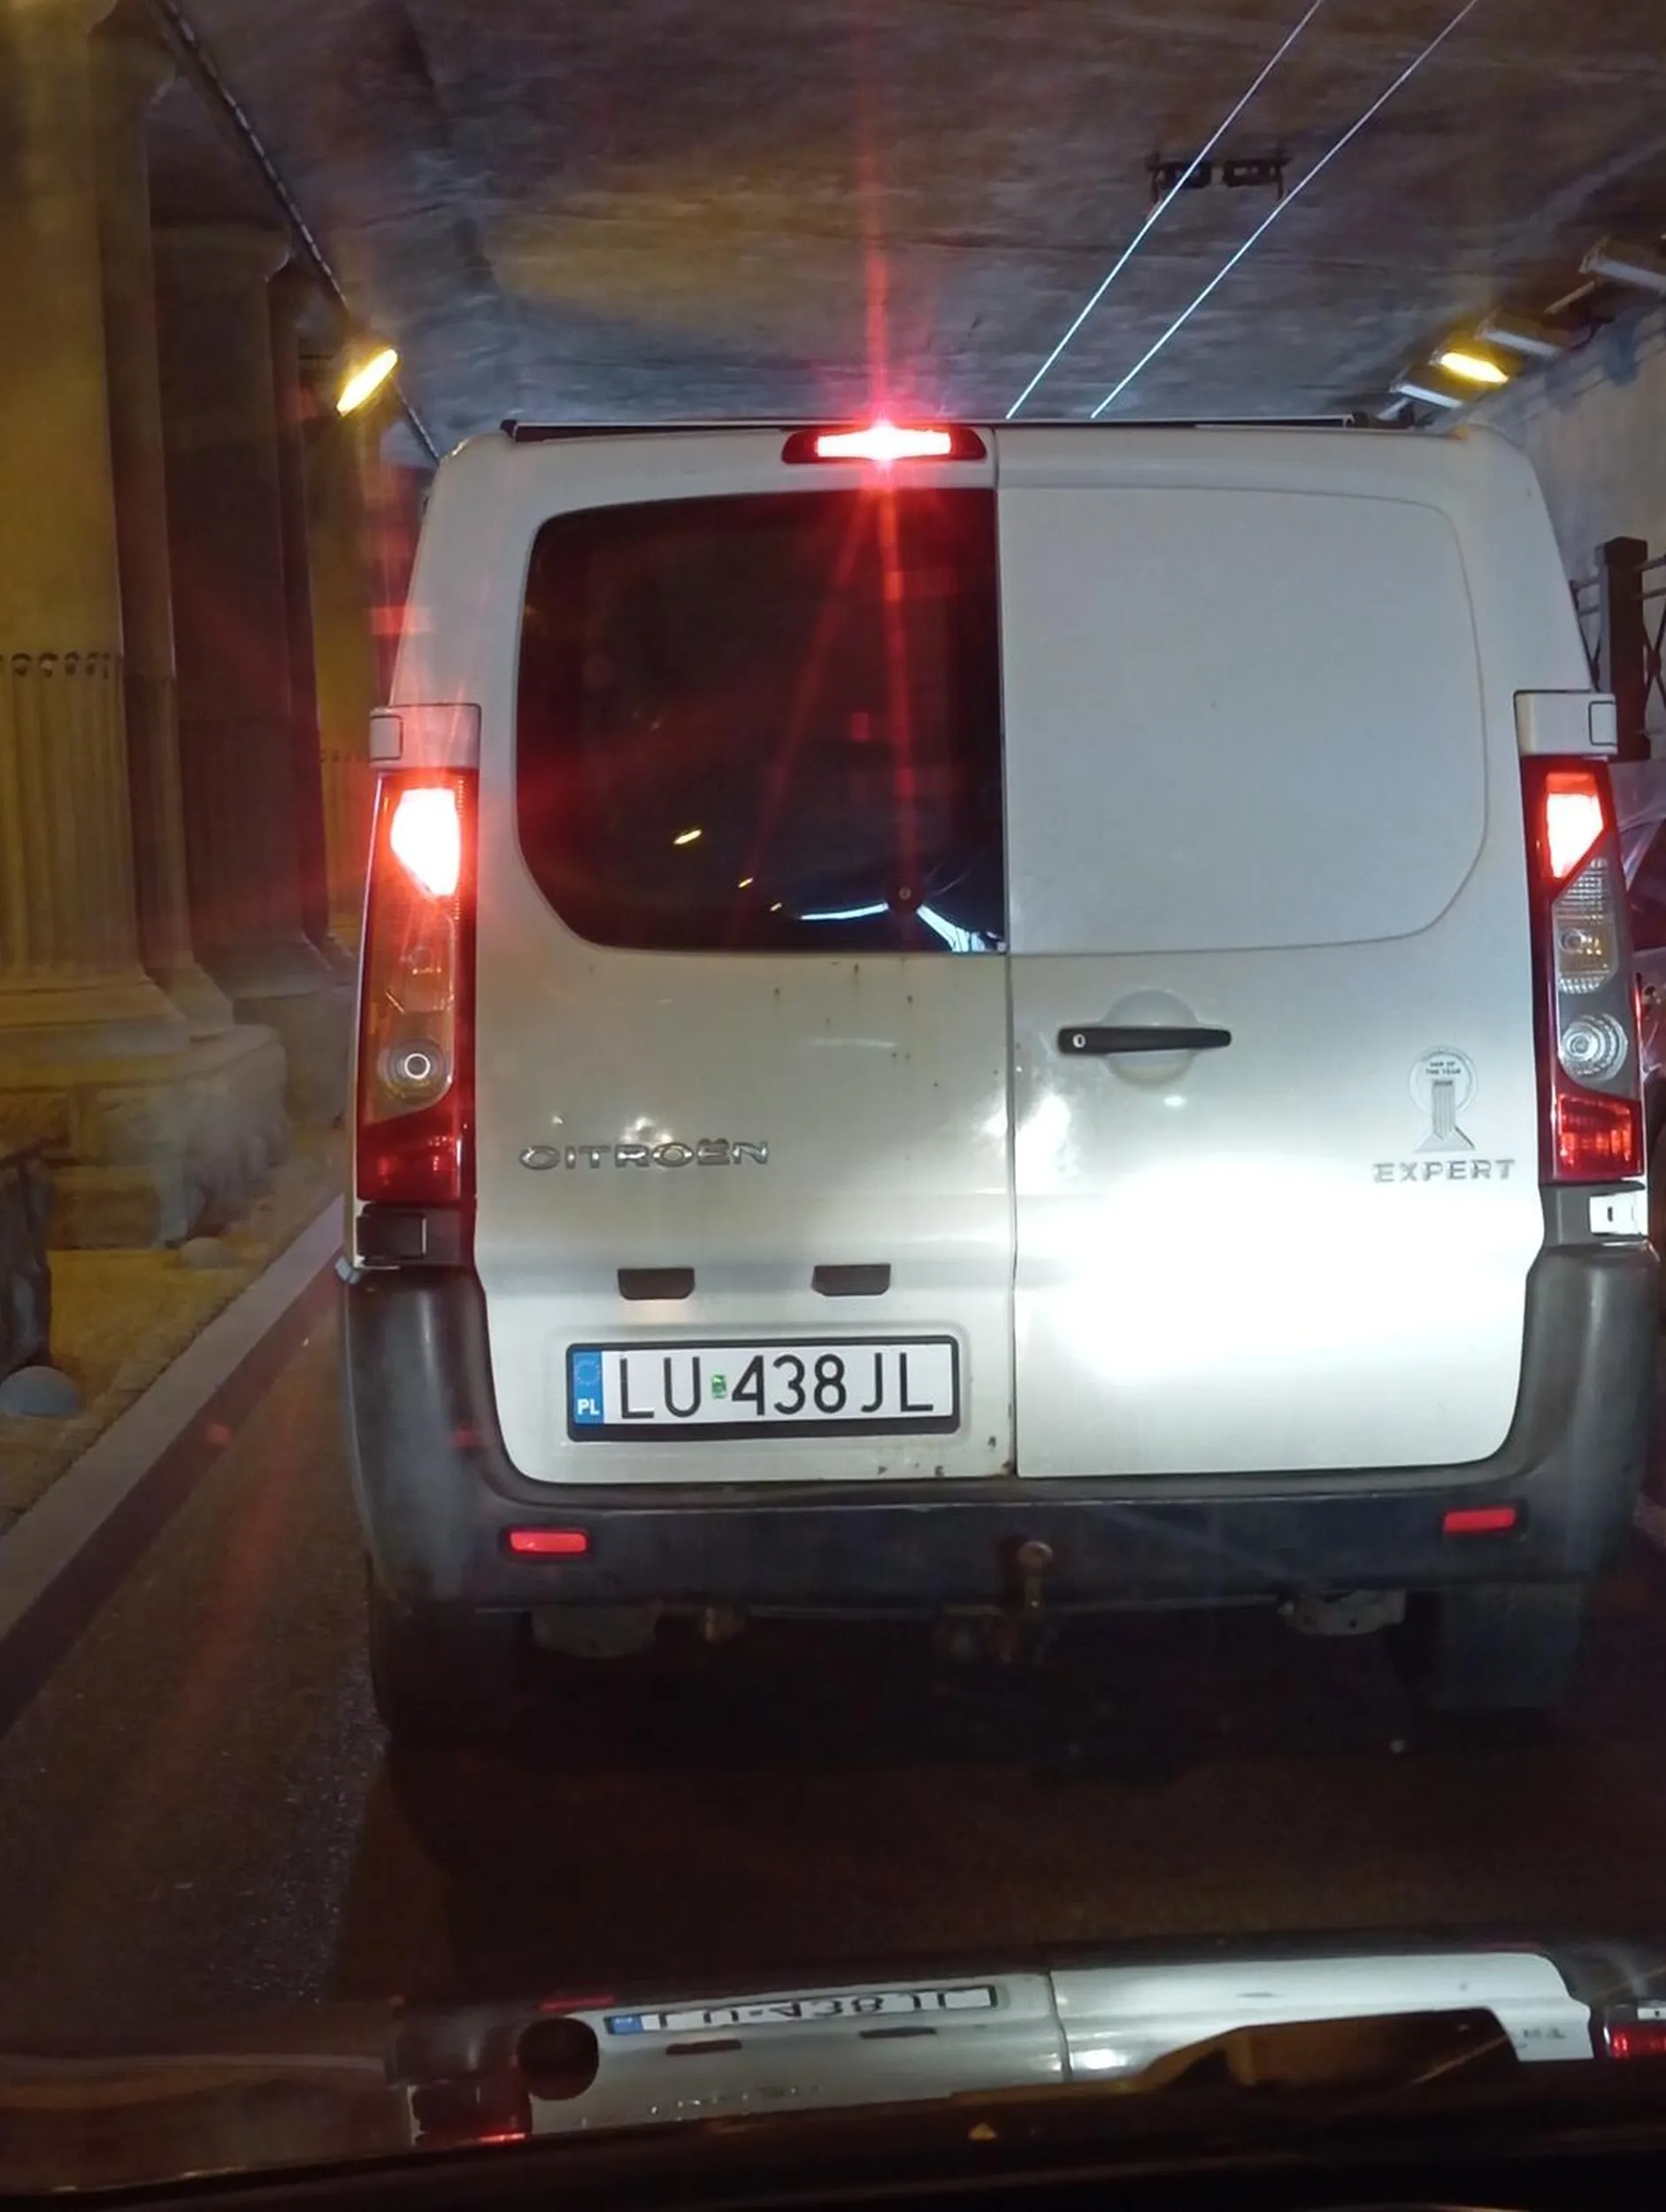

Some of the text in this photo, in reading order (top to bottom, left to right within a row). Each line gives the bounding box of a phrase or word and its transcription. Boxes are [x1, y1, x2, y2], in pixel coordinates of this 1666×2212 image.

[519, 1138, 768, 1171] CITROËN
[1372, 1159, 1516, 1183] EXPERT
[619, 1353, 933, 1418] LU 438JL
[577, 1399, 600, 1415] PL
